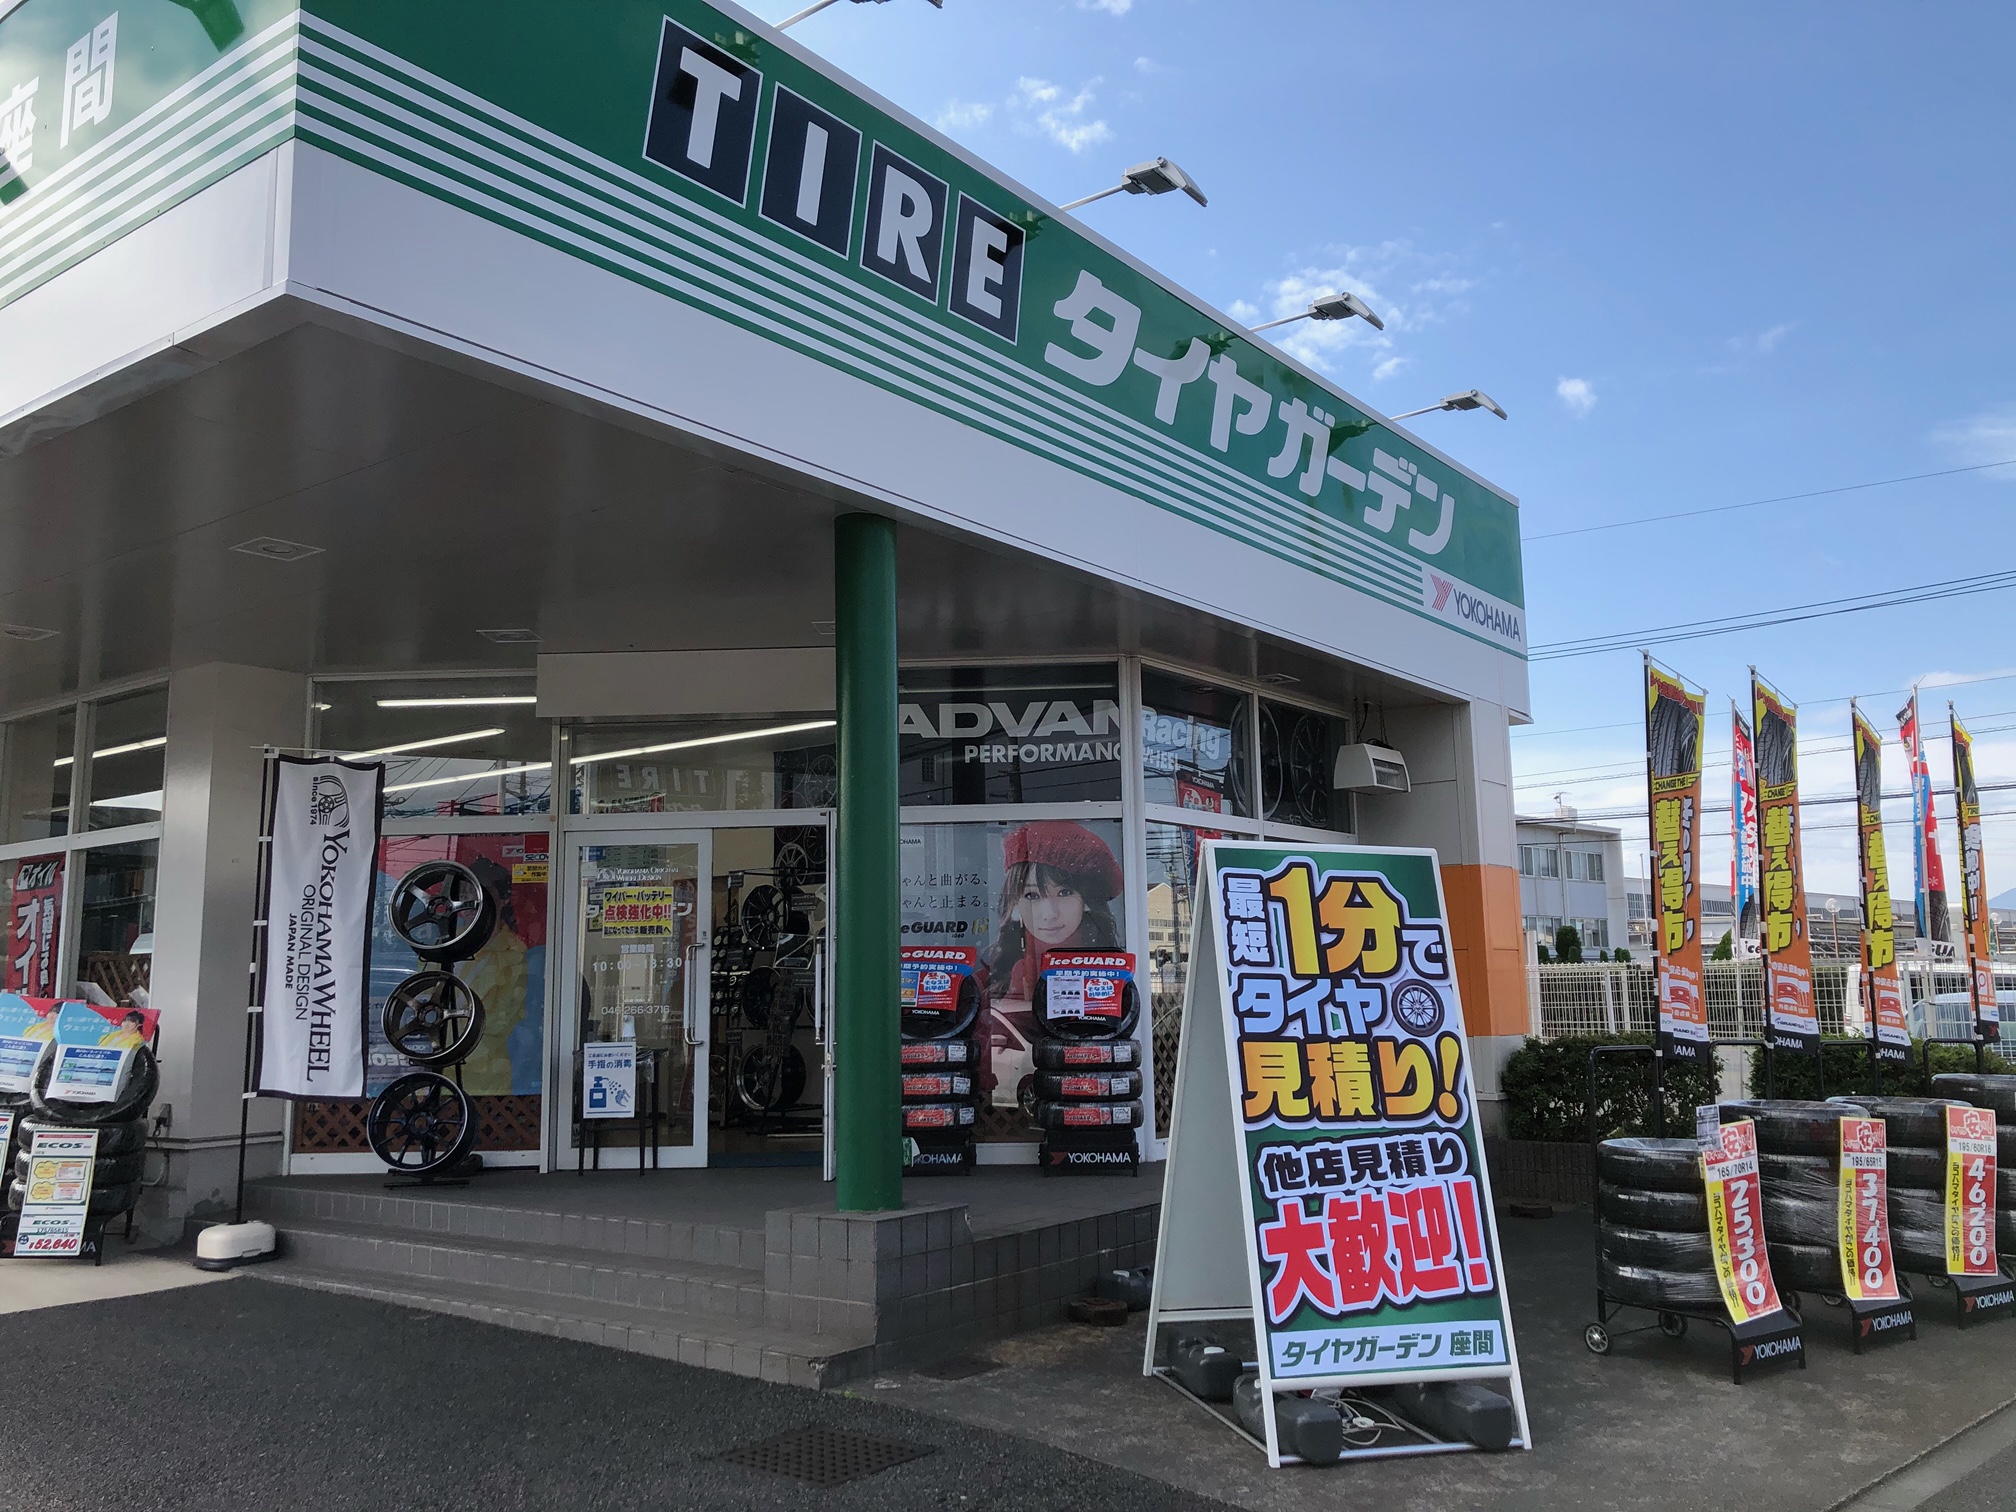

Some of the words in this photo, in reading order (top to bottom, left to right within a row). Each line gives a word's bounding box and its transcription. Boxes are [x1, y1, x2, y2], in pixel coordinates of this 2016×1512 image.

[680, 46, 1007, 319] TIRE
[1044, 269, 1455, 555] タイヤガーデン
[1453, 588, 1521, 642] YOKOHAMA
[310, 804, 318, 825] 1974
[313, 829, 350, 980] YOKOHAMA
[604, 890, 673, 902] ワイパー・バッテリー
[287, 913, 298, 951] JAPAN
[299, 884, 316, 959] ORIGINAL
[15, 898, 40, 994] オイ
[620, 944, 655, 954] 営業時間
[1049, 956, 1127, 966] iceGUARD
[285, 955, 295, 989] MADE
[901, 963, 958, 972] 期予約実施中!
[295, 964, 311, 1020] DESIGN
[1238, 978, 1384, 1035] タイヤ
[306, 979, 336, 1082] WHEEL
[587, 1059, 633, 1070] 手指の消毒
[1241, 1036, 1460, 1118] 見積り!
[1067, 1151, 1132, 1164] YOKOHAMA
[1262, 1137, 1466, 1193] 他店見積り
[1716, 1161, 1753, 1179] 165/70R14
[1851, 1153, 1882, 1168] 195/65R15
[1862, 1172, 1884, 1289] 37,400
[1967, 1157, 1987, 1266] 46,200
[1263, 1180, 1489, 1318] 大歓迎!
[1730, 1179, 1767, 1305] 25,300
[1975, 1289, 2015, 1309] YOKOHAMA
[1872, 1310, 1914, 1332] YOKOHAMA
[1280, 1331, 1442, 1368] タイヤガーデン
[1449, 1329, 1494, 1357] 座間
[1754, 1335, 1802, 1360] YOKOHAMA
